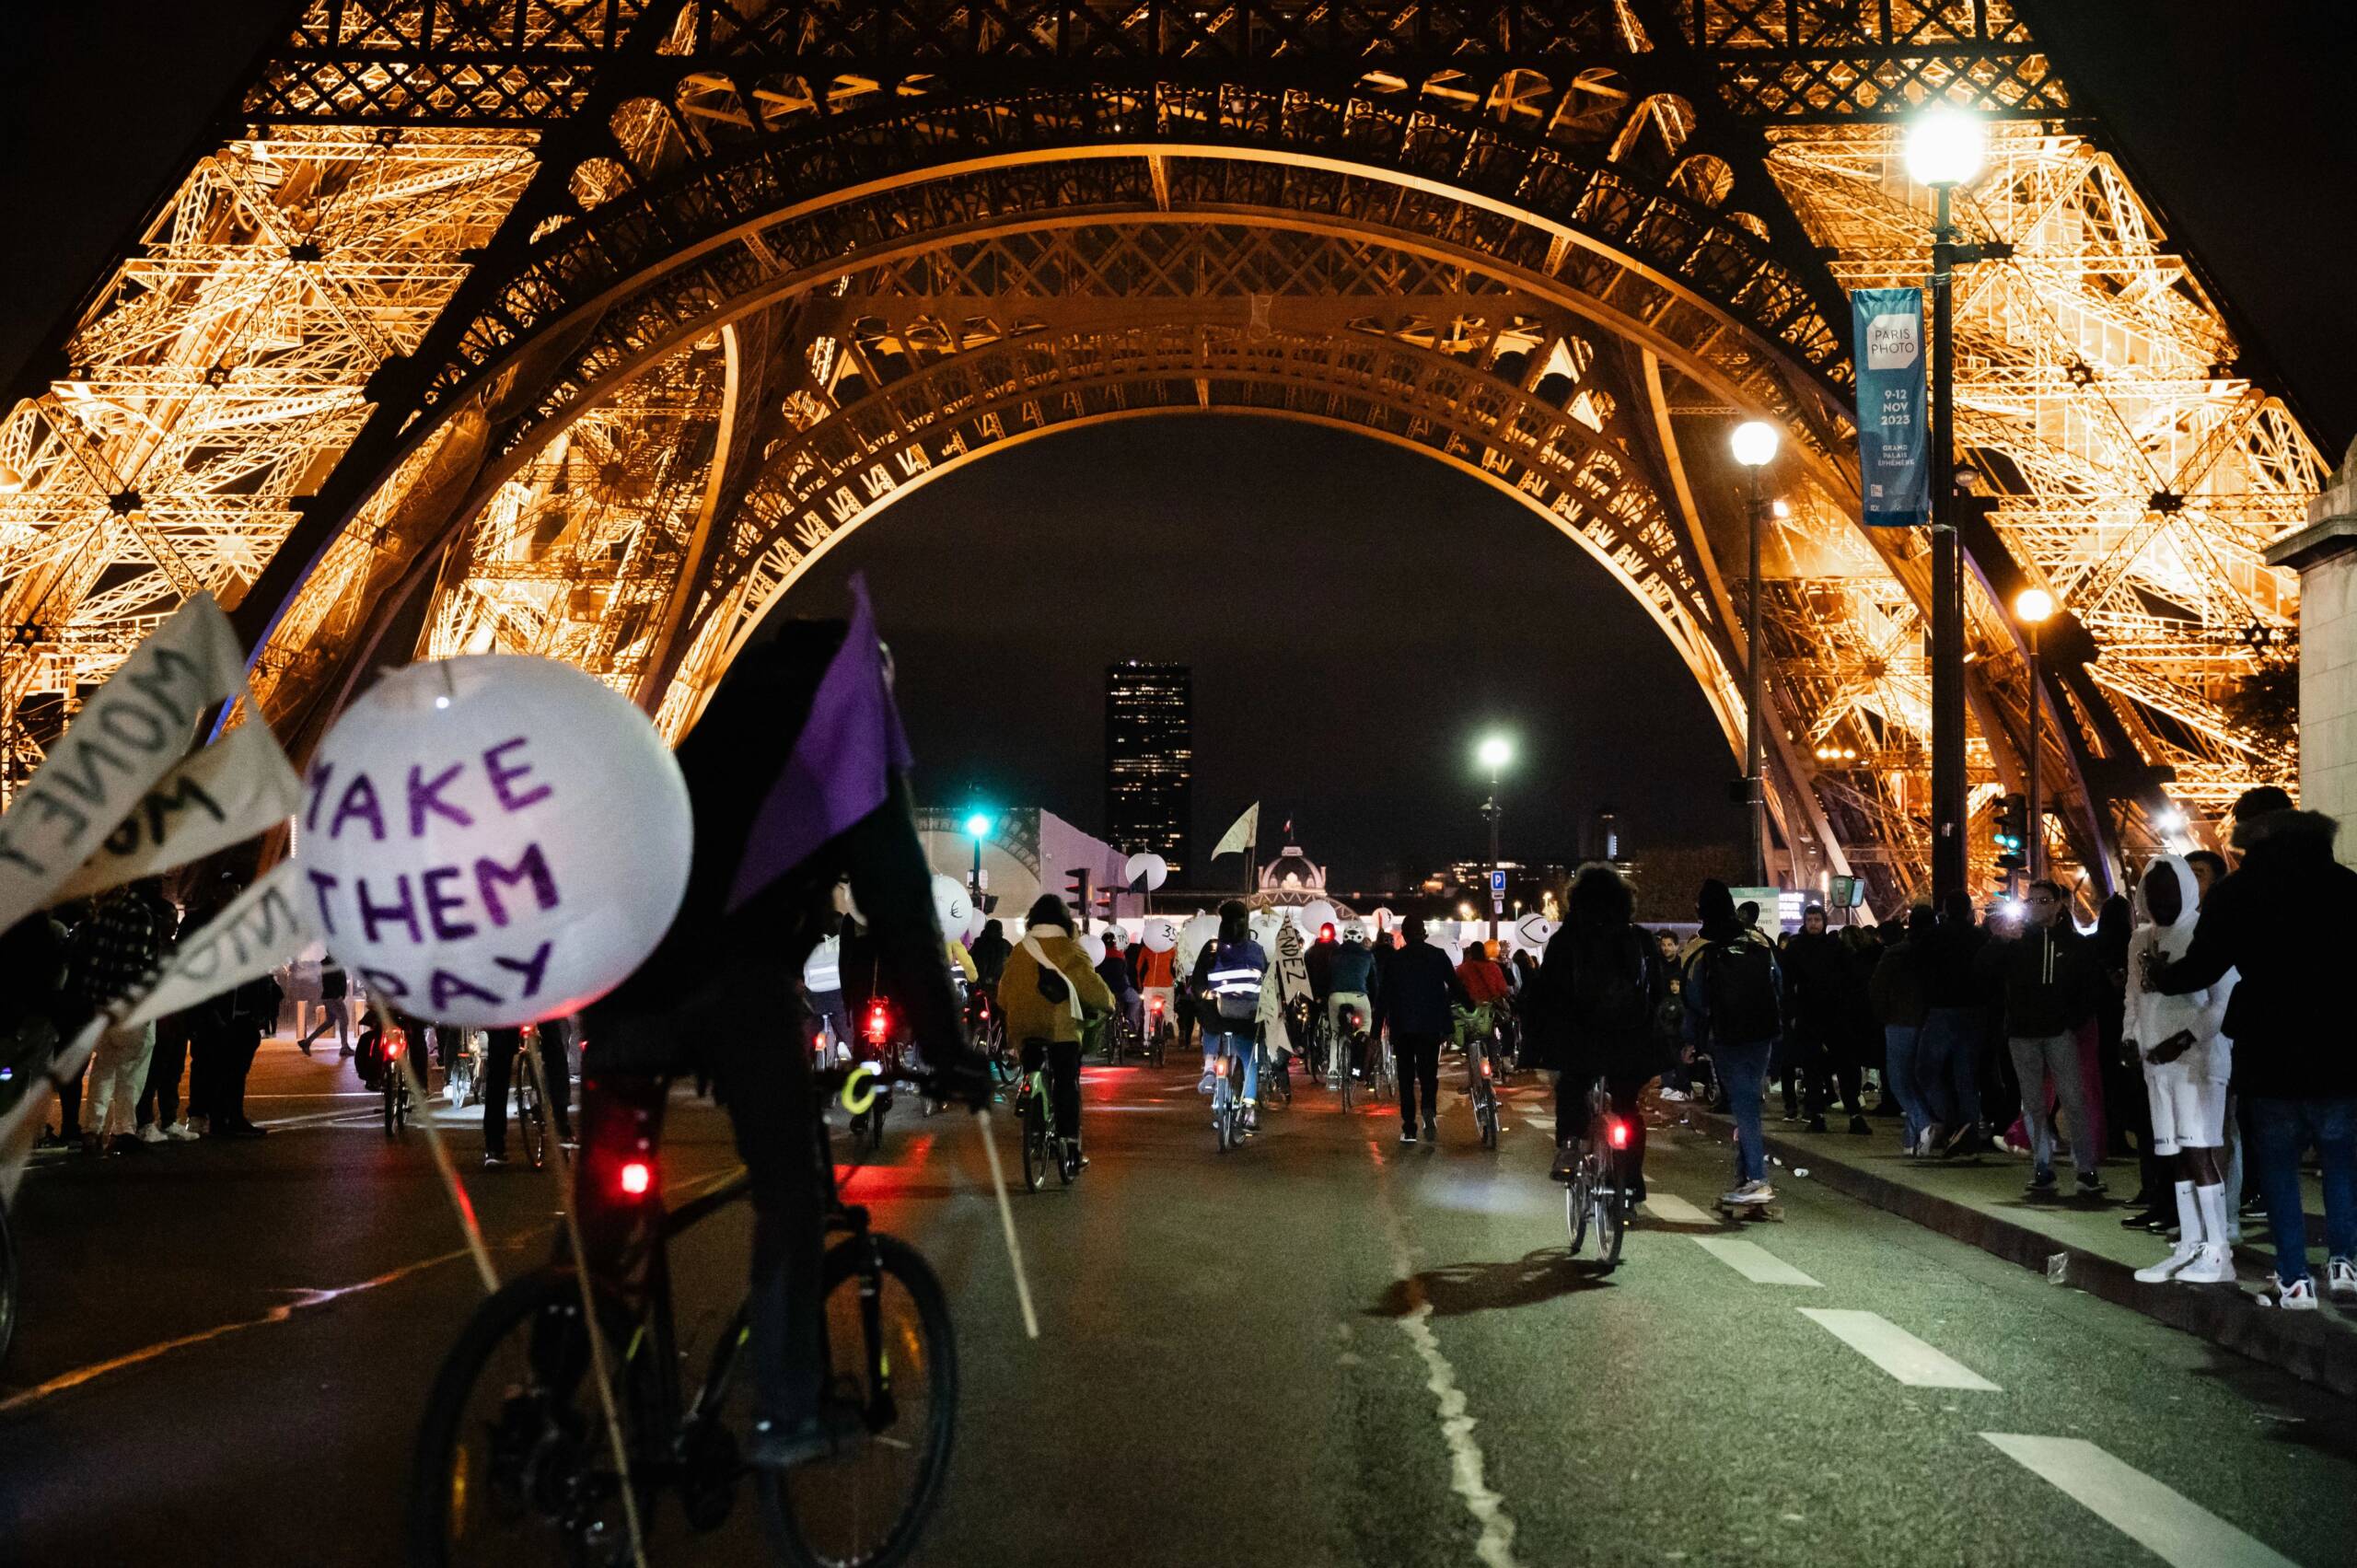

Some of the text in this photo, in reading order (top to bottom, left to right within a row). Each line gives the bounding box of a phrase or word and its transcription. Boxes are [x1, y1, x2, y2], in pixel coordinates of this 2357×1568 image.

[1875, 328, 1910, 341] PARIS
[1871, 342, 1915, 354] PHOTO
[1885, 389, 1907, 400] 9-12
[1883, 401, 1908, 412] NOV
[1881, 414, 1910, 425] 2023
[1494, 875, 1502, 887] P
[307, 842, 560, 944] THEM
[357, 941, 552, 1011] PAY
